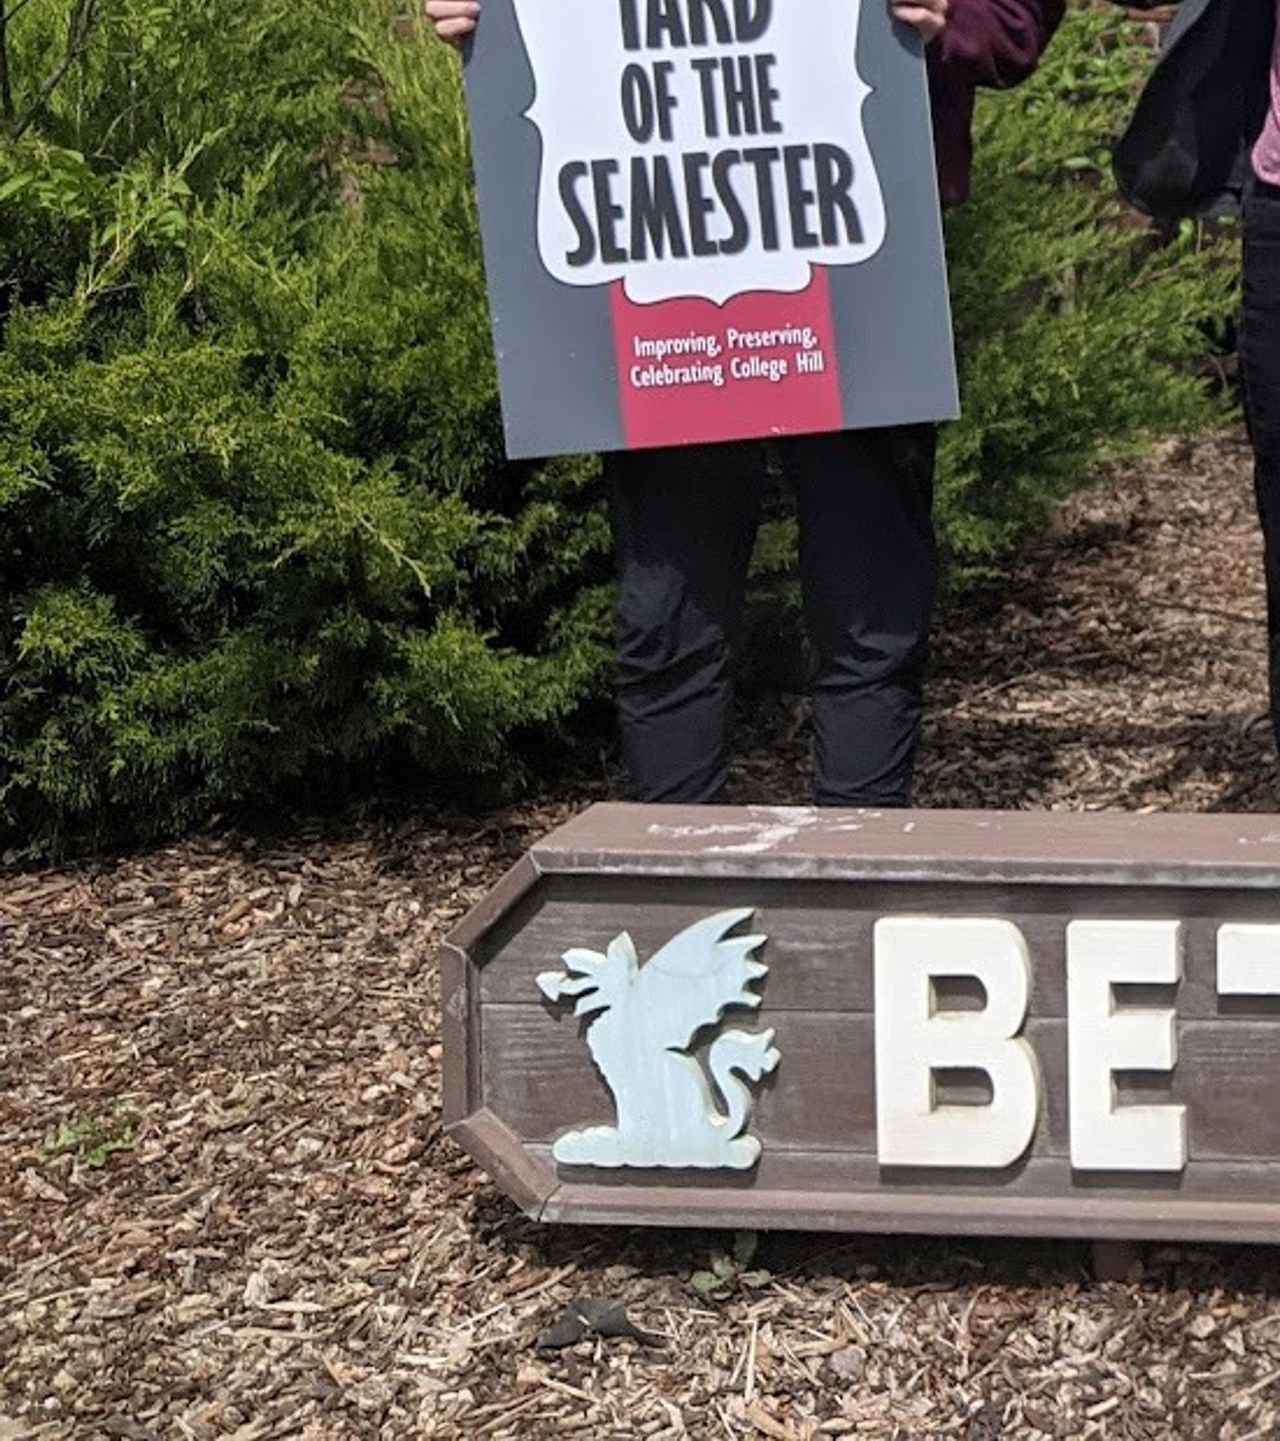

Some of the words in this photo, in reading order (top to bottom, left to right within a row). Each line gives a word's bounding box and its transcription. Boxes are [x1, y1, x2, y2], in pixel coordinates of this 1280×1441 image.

[620, 61, 678, 144] OF
[690, 53, 783, 138] THE
[557, 142, 865, 267] SEMESTER
[630, 360, 725, 387] Celebrating
[730, 356, 788, 382] College
[795, 349, 825, 373] Hill
[633, 330, 722, 362] Improving,
[726, 323, 818, 349] Preserving,
